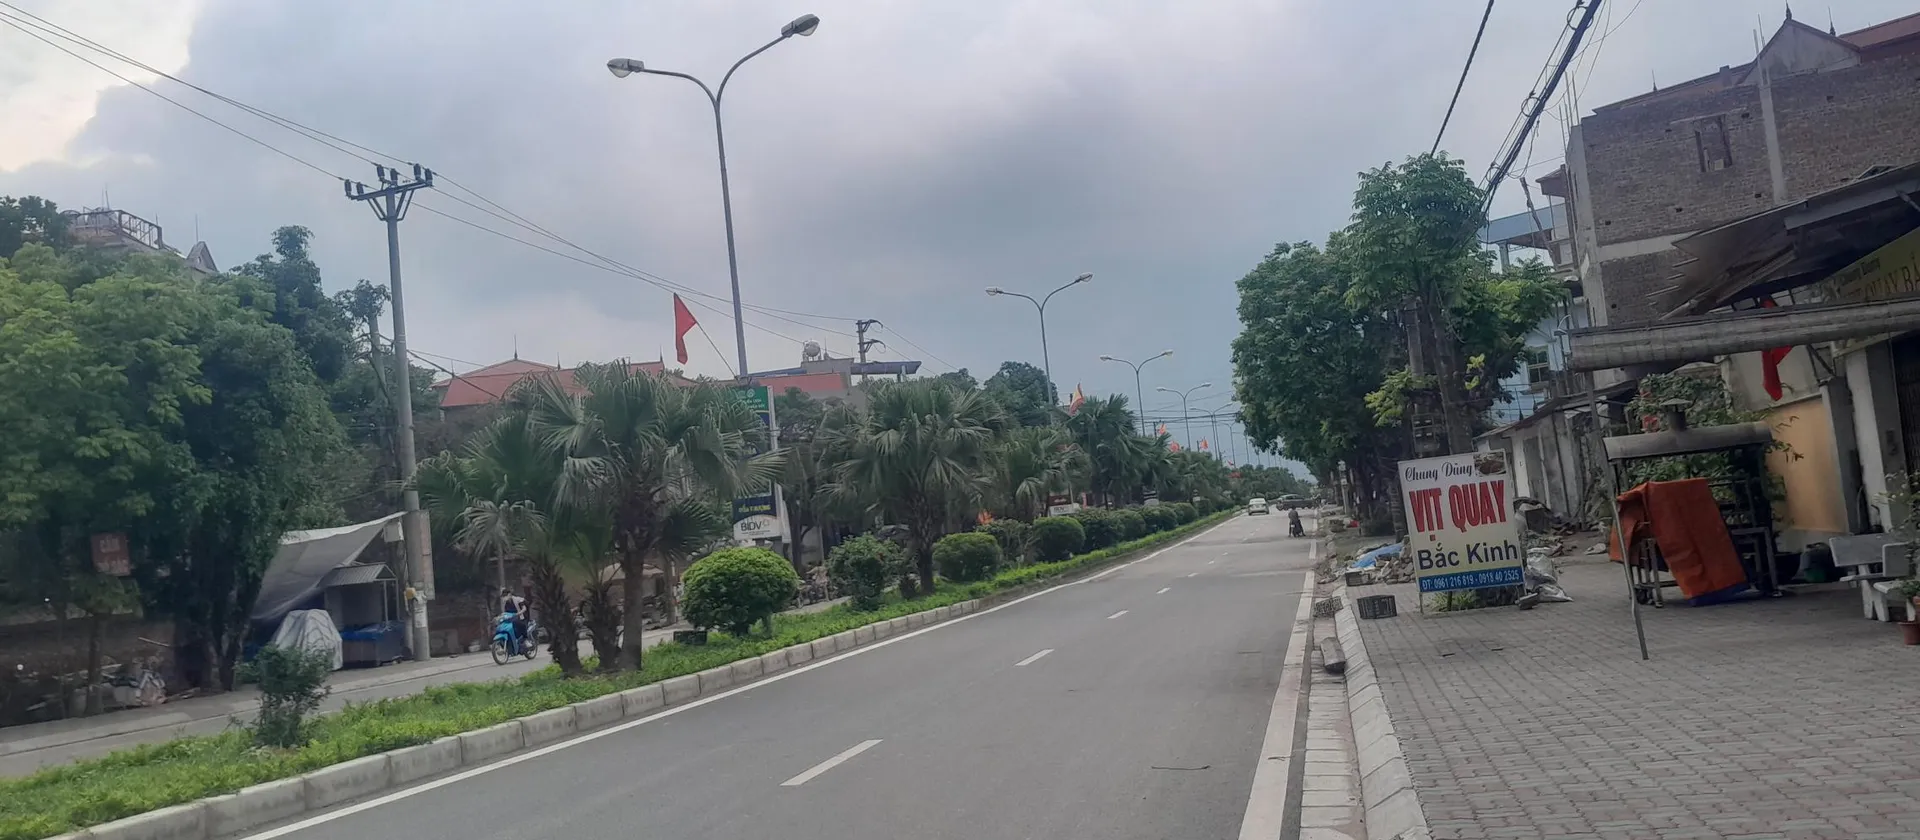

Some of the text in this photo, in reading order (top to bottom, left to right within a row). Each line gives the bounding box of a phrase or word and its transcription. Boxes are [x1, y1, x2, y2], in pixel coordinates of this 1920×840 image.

[1405, 461, 1473, 482] Chung Dũng
[1408, 480, 1507, 542] VỊT QUAY
[1417, 540, 1518, 570] Bắc Kinh
[1504, 569, 1520, 581] 2525
